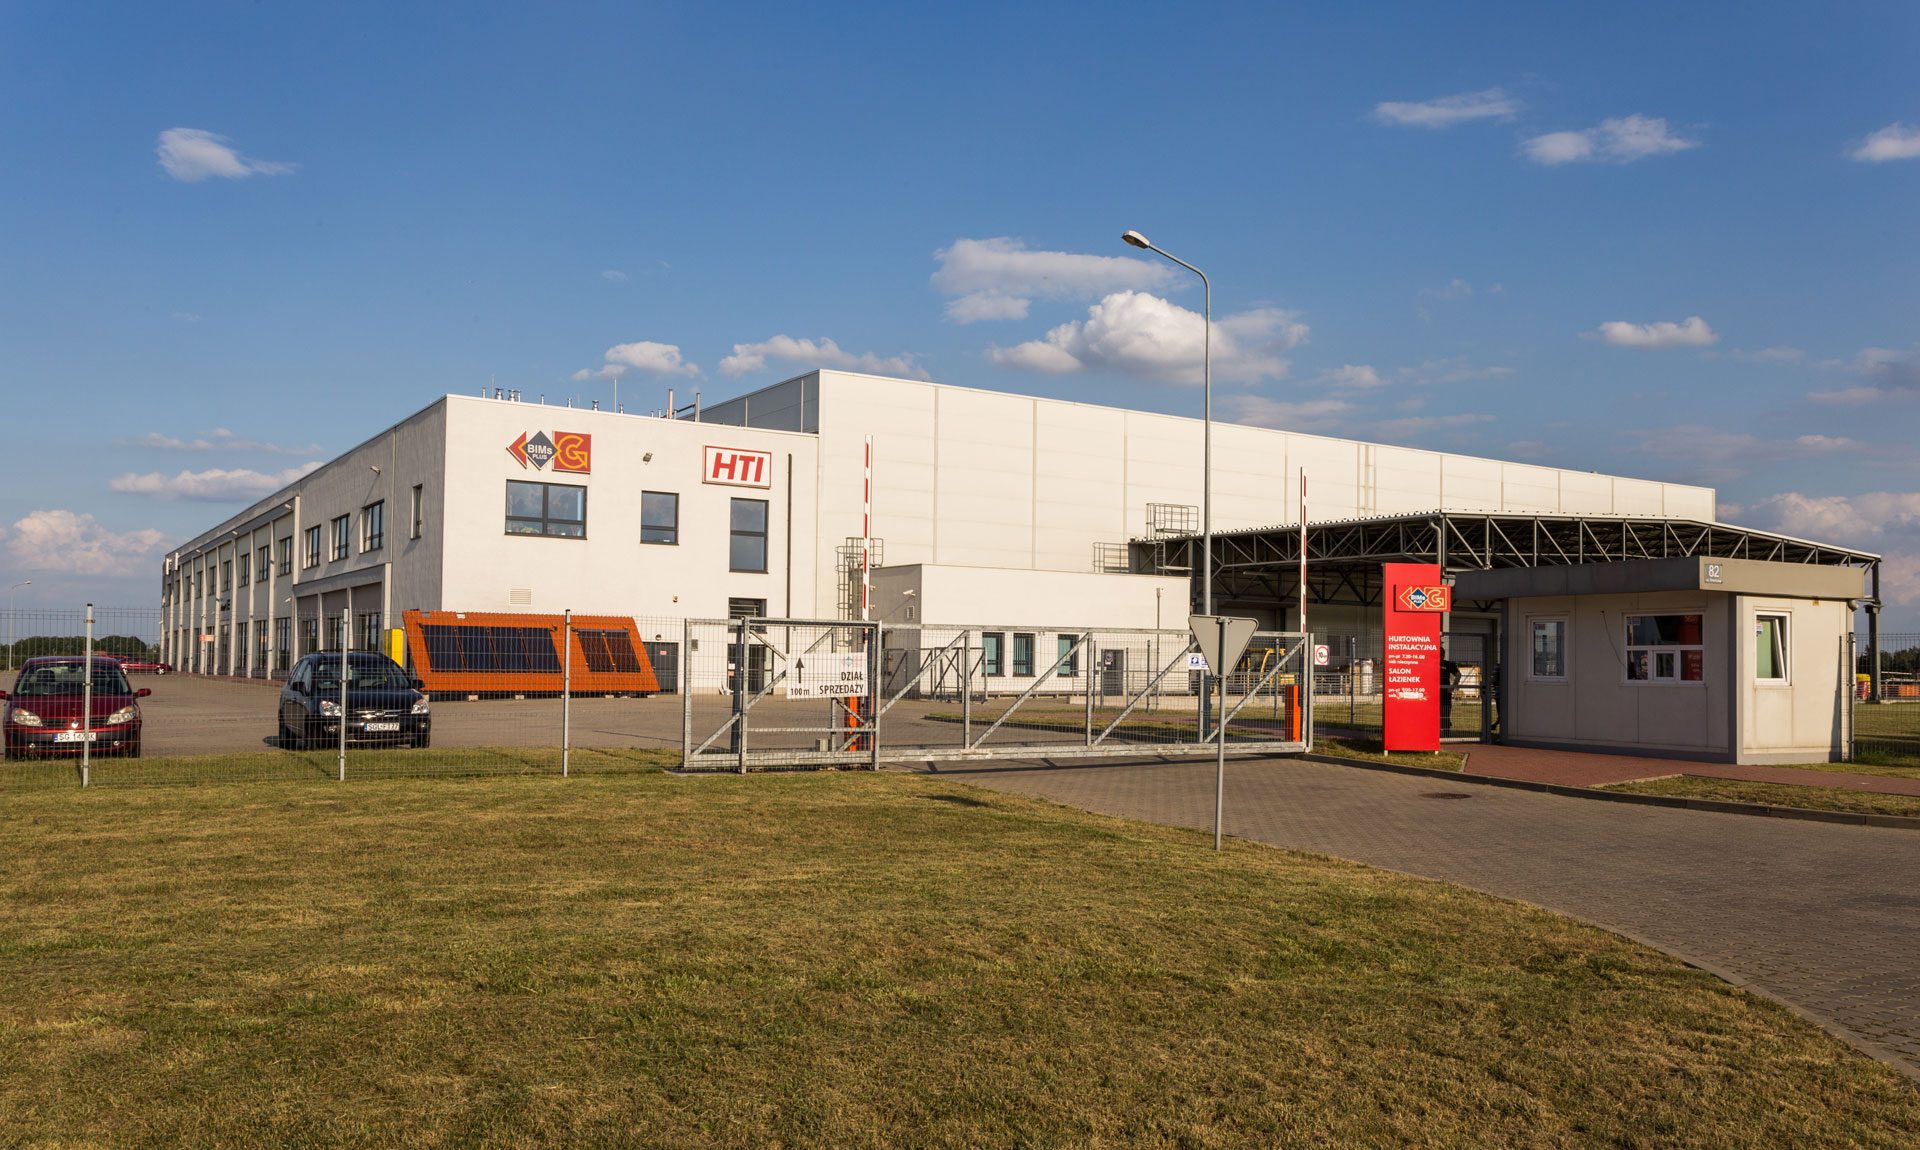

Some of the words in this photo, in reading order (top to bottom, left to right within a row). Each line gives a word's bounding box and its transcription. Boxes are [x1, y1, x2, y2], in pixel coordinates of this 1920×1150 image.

[527, 444, 553, 455] BIMs
[712, 452, 764, 483] HTI
[1709, 565, 1720, 578] 82
[1388, 635, 1431, 643] HURTOWNIA
[1388, 643, 1437, 651] INSTALACYJNA
[841, 671, 864, 681] DZIAŁ
[790, 687, 803, 696] 100
[803, 688, 810, 696] m
[819, 683, 864, 695] SPRZEDAŻY
[58, 733, 70, 741] SG
